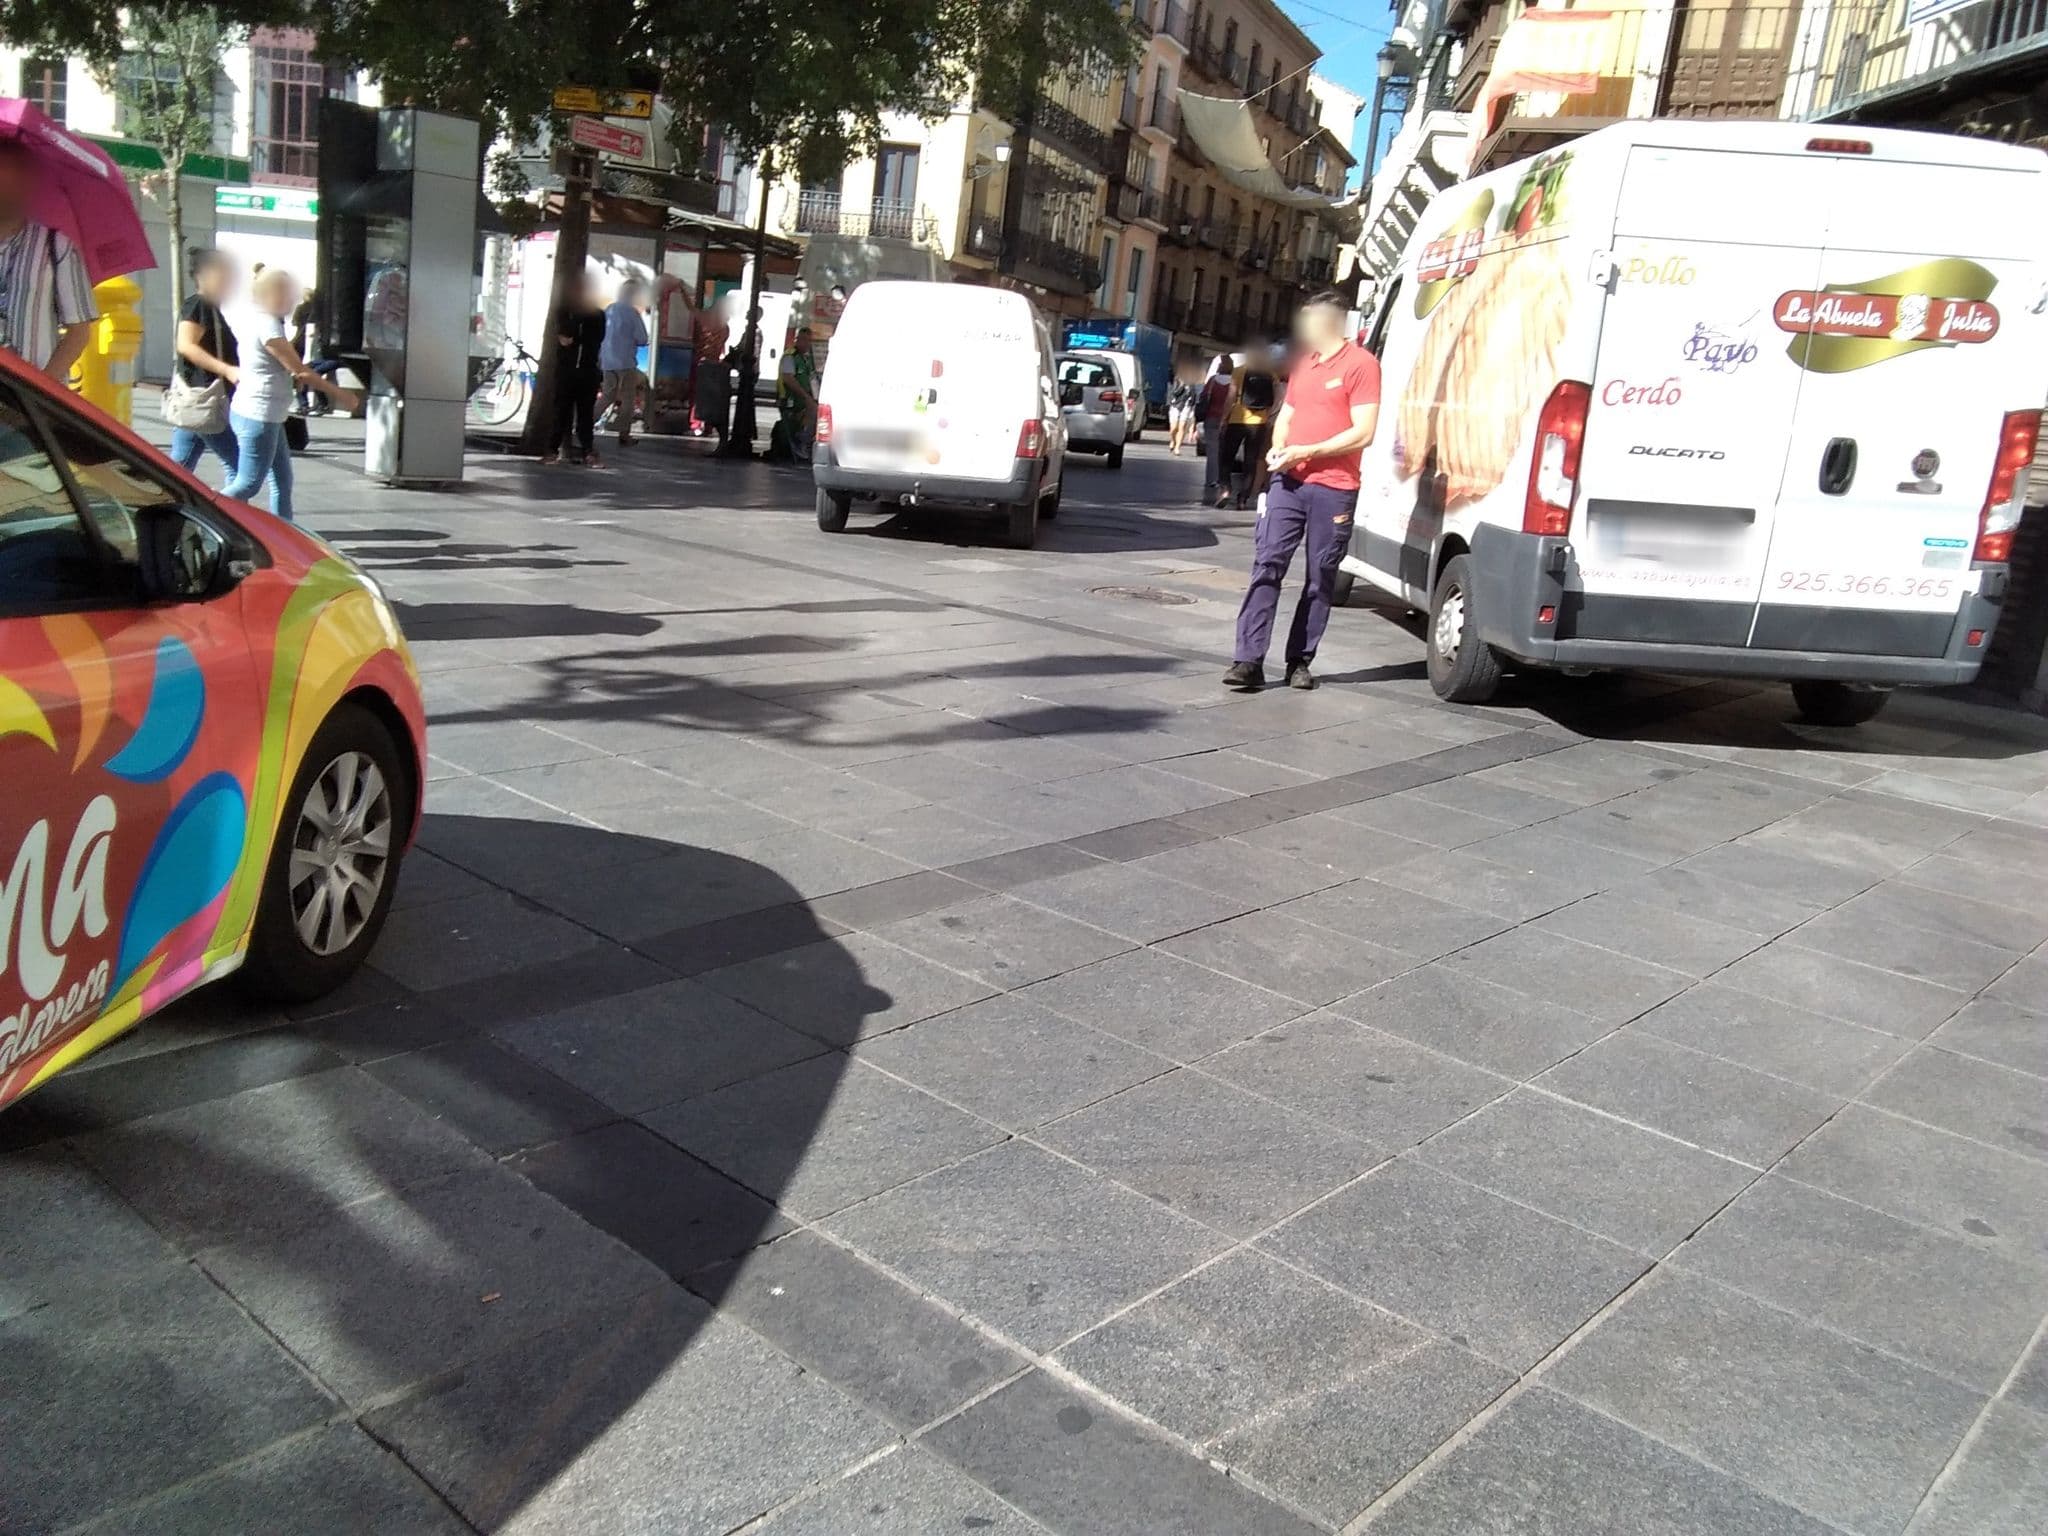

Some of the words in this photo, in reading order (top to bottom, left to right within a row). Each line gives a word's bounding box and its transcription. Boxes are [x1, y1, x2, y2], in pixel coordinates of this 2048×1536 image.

[1622, 256, 1696, 286] Pollo
[1780, 296, 1811, 323] La
[1812, 297, 1883, 328] Abuela
[1938, 303, 1993, 337] Julia
[1683, 336, 1759, 363] Pavo
[1602, 376, 1682, 407] Cerdo
[1628, 445, 1726, 461] DUCATO
[1778, 571, 1953, 598] 925.366.365
